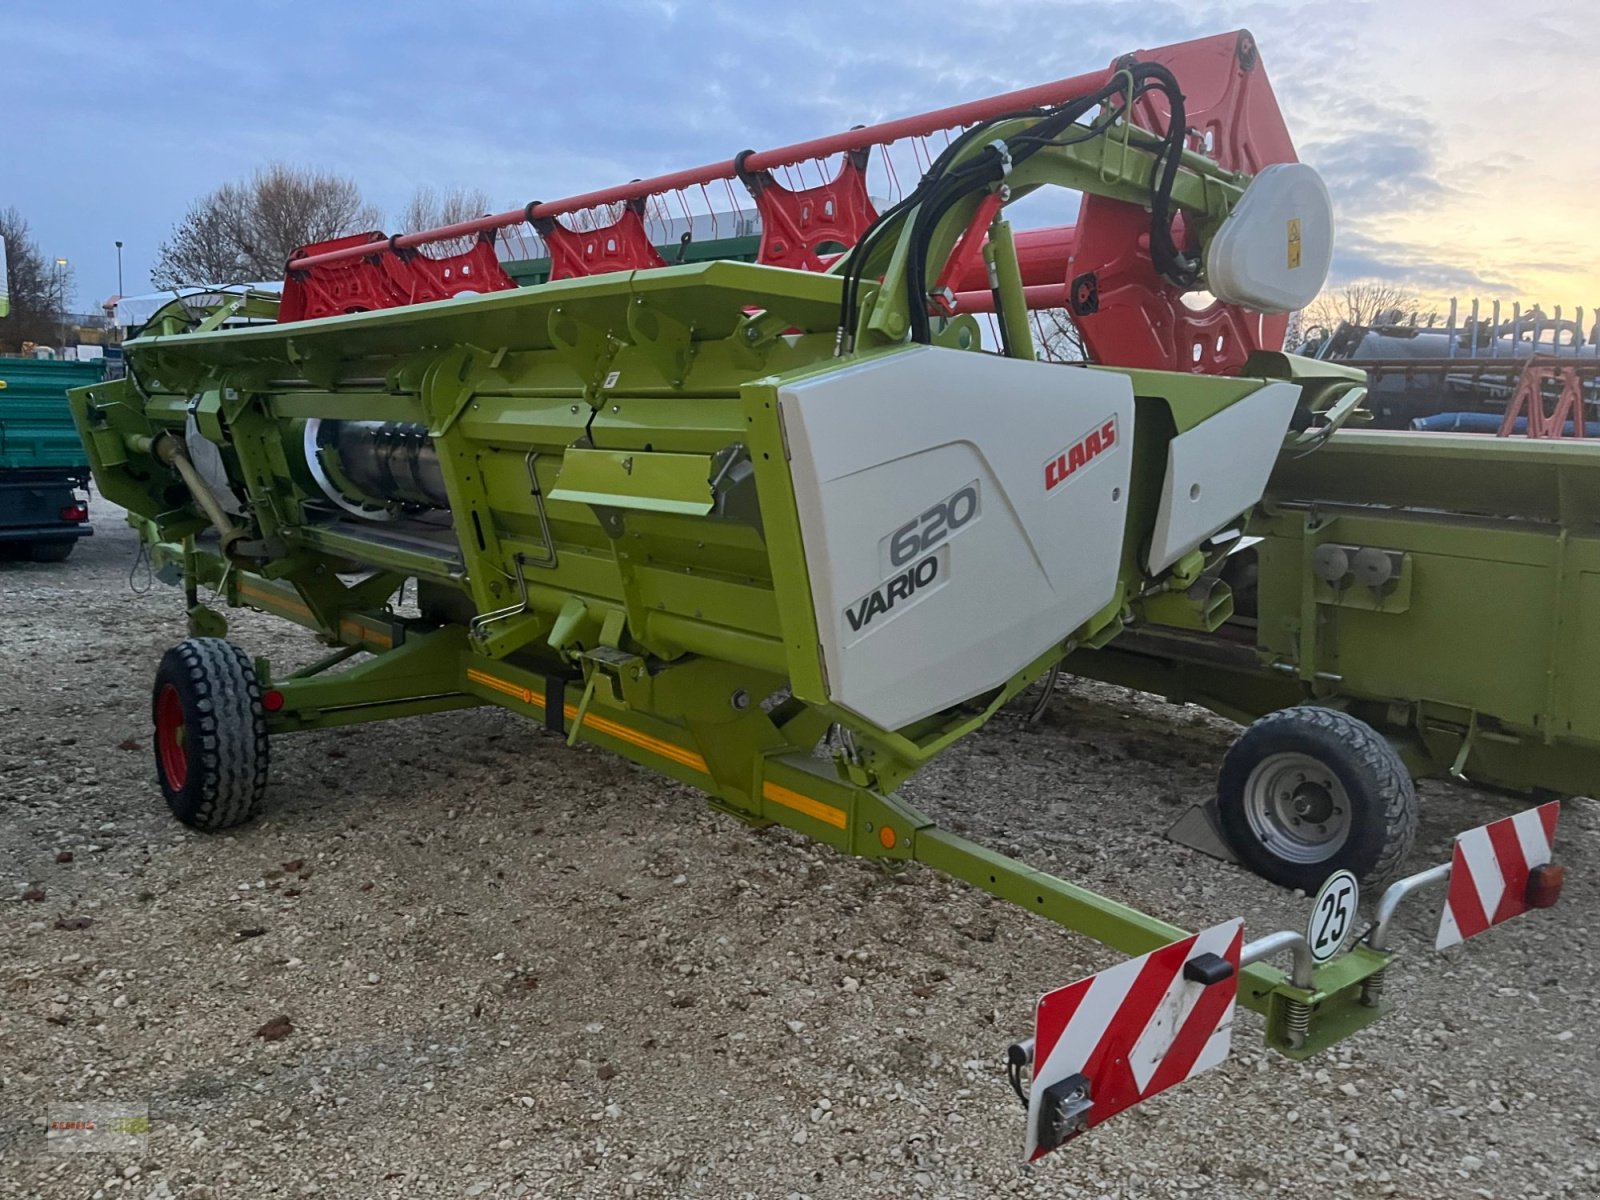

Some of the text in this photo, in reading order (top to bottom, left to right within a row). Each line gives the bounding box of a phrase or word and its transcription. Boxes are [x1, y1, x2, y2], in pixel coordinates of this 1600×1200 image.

[1045, 420, 1115, 491] CLAAS
[890, 487, 976, 568] 620
[845, 556, 938, 632] VARIO
[1315, 886, 1351, 950] 25
